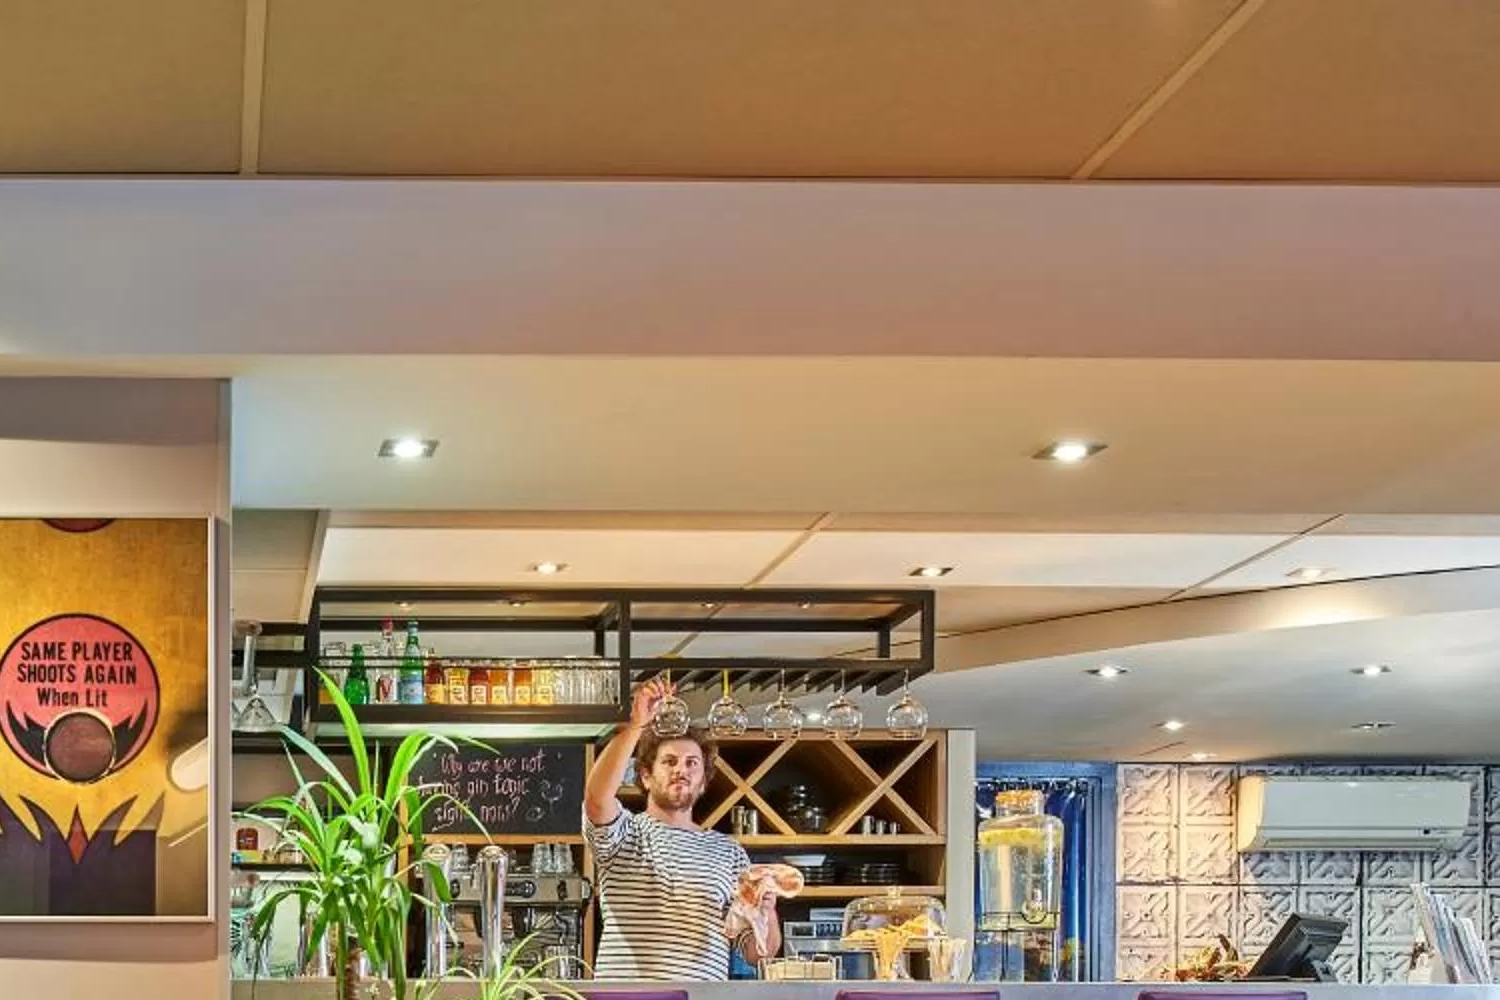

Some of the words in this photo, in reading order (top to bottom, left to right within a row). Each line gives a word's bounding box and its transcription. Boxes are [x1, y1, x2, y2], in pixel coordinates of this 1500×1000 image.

[21, 641, 67, 661] SAME
[71, 641, 133, 661] PLAYER
[17, 663, 77, 683] SHOOTS
[84, 664, 137, 685] AGAIN
[37, 687, 79, 707] When
[85, 688, 108, 708] Lit
[521, 748, 546, 773] not
